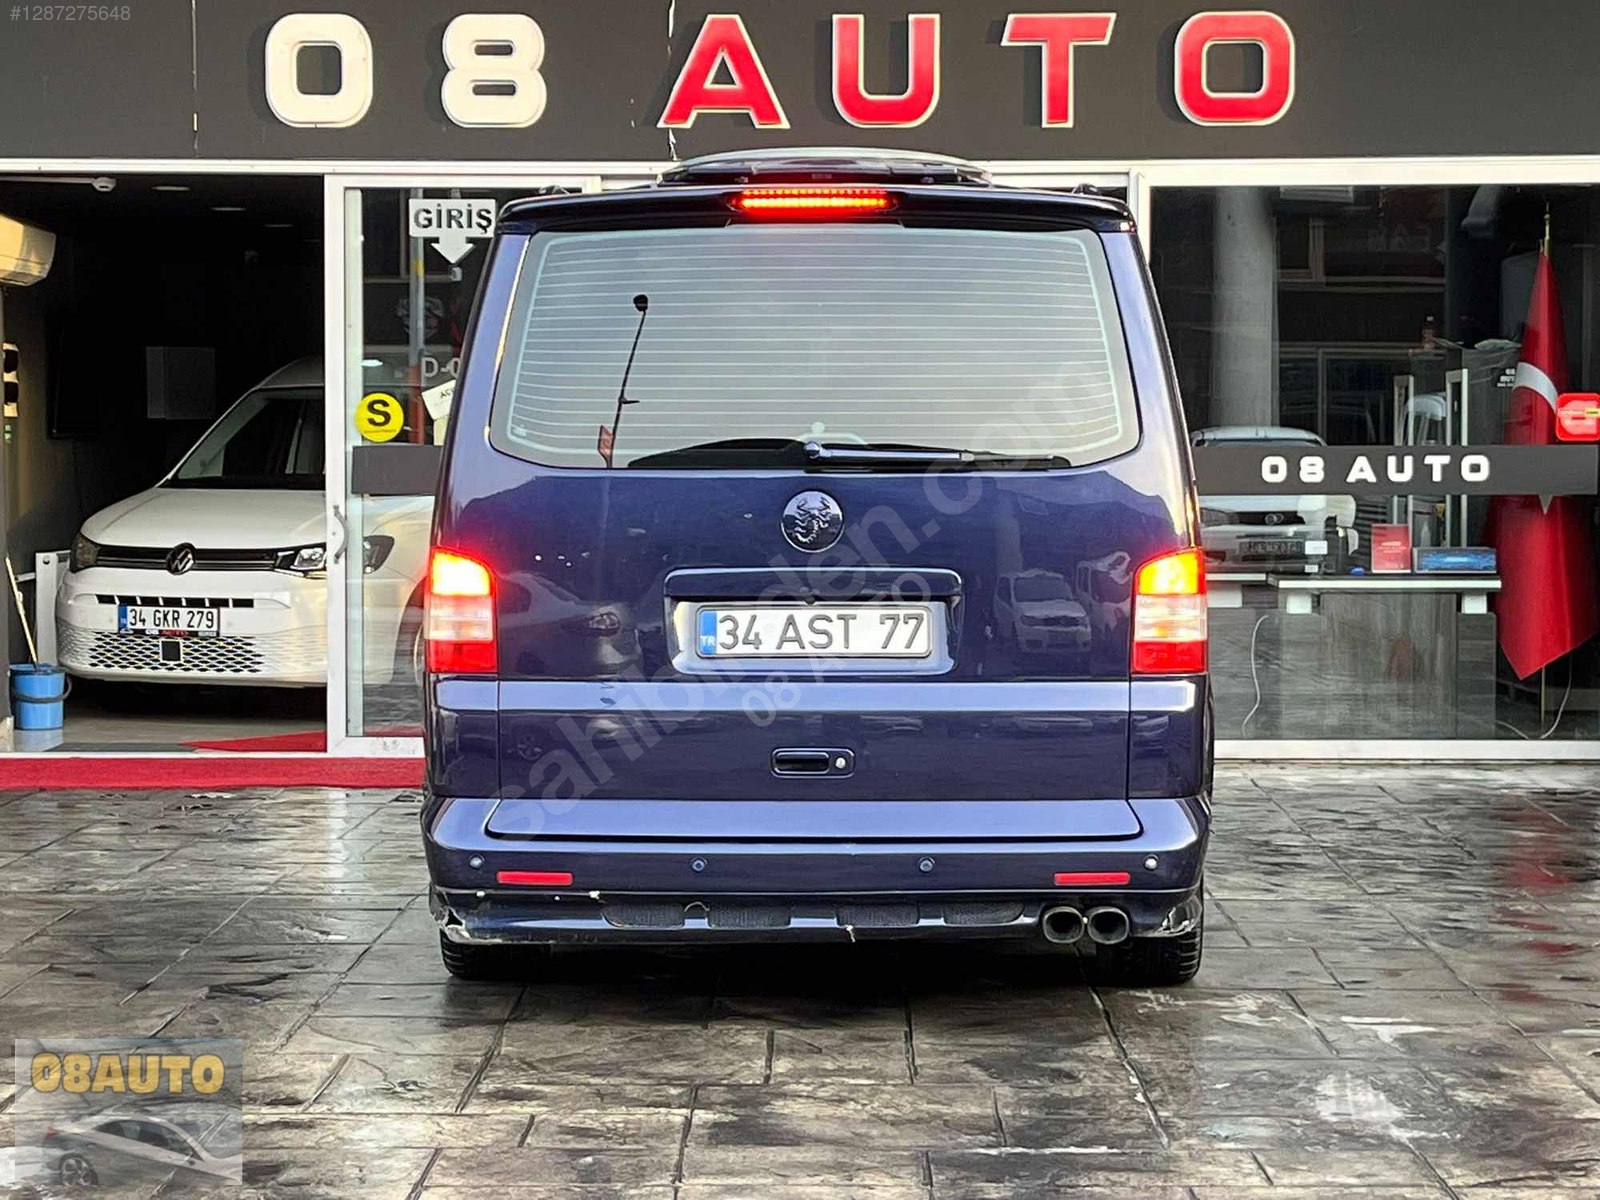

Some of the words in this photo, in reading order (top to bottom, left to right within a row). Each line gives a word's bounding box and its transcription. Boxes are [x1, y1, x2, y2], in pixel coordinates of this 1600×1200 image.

[265, 13, 547, 128] 08
[657, 11, 1295, 129] AUTO
[414, 203, 492, 234] GİRİŞ
[367, 399, 391, 427] S
[1261, 455, 1325, 483] 08
[1346, 455, 1490, 483] AUTO
[129, 608, 146, 626] 34
[153, 609, 180, 627] GKR
[186, 610, 214, 629] 279
[700, 635, 716, 647] TR
[718, 614, 762, 650] 34
[776, 613, 857, 650] AST
[879, 613, 925, 650] 77
